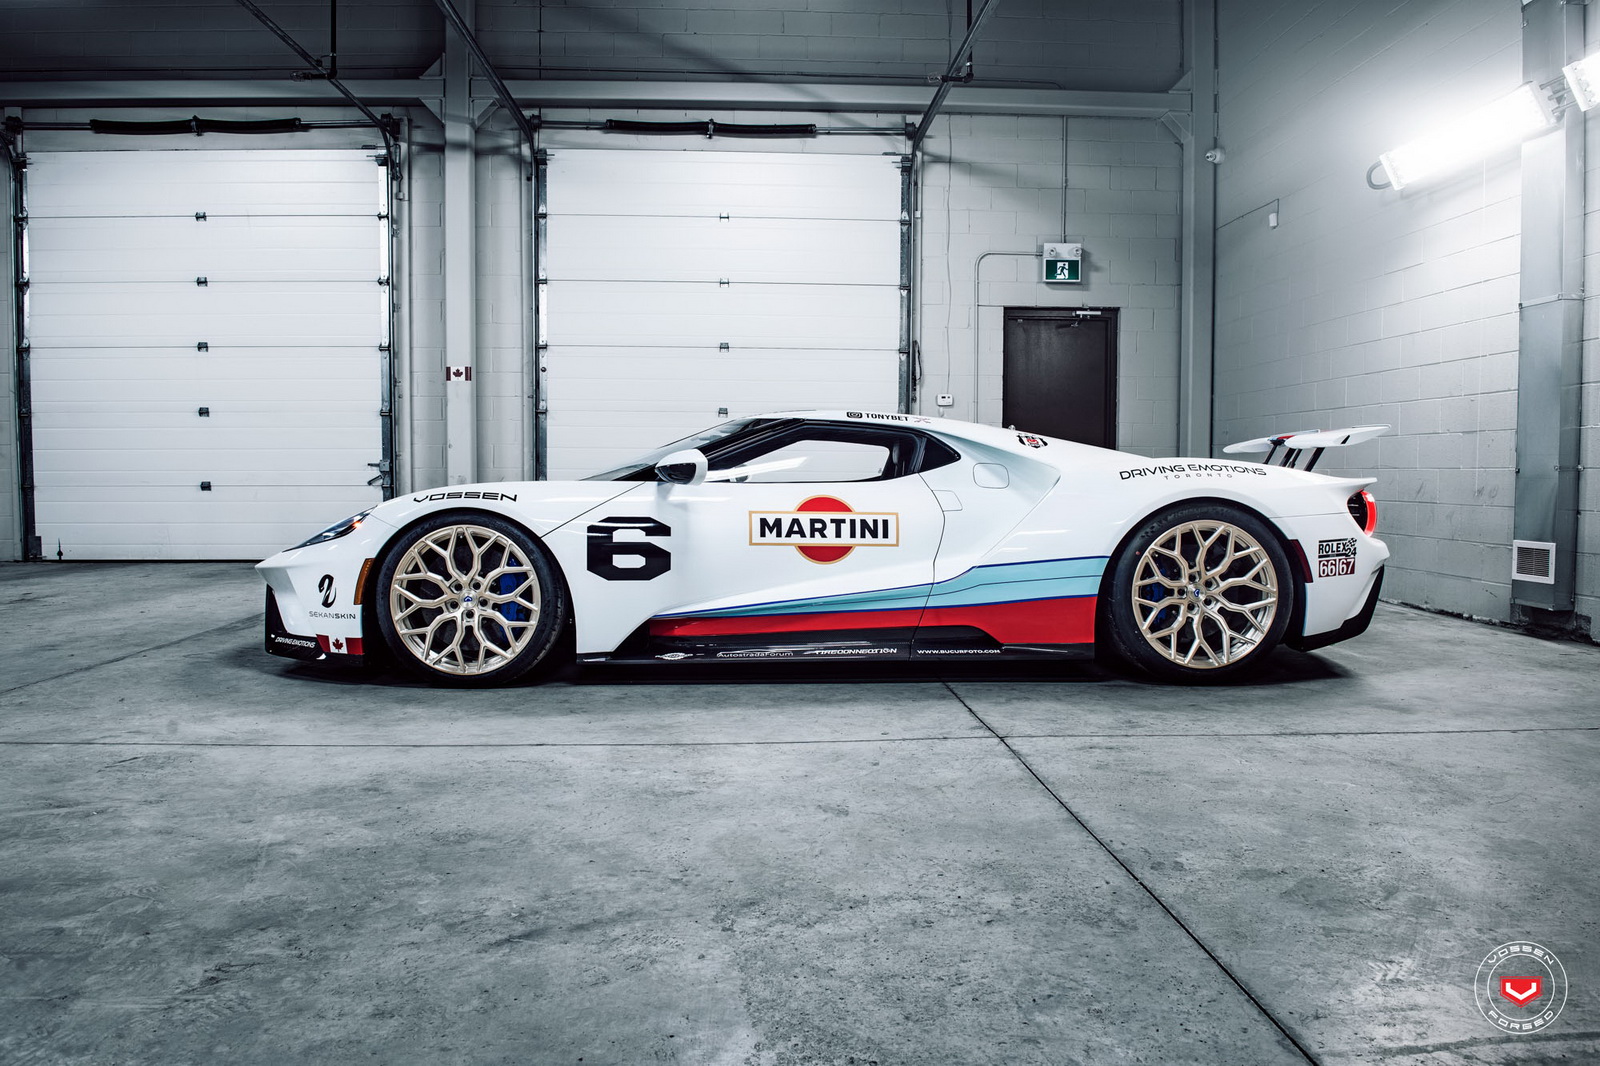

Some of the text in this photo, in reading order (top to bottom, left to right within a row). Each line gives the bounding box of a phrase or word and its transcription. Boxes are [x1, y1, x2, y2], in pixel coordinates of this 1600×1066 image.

[865, 412, 909, 421] TONYBET
[1119, 464, 1267, 480] DRIVING EMOTIONS
[1164, 472, 1233, 480] TORONTO
[413, 491, 518, 503] VOSSEN
[759, 517, 889, 539] MARTINI
[587, 516, 671, 581] 6
[1318, 542, 1357, 557] ROLEX 24
[308, 611, 356, 620] SEKANSKIN
